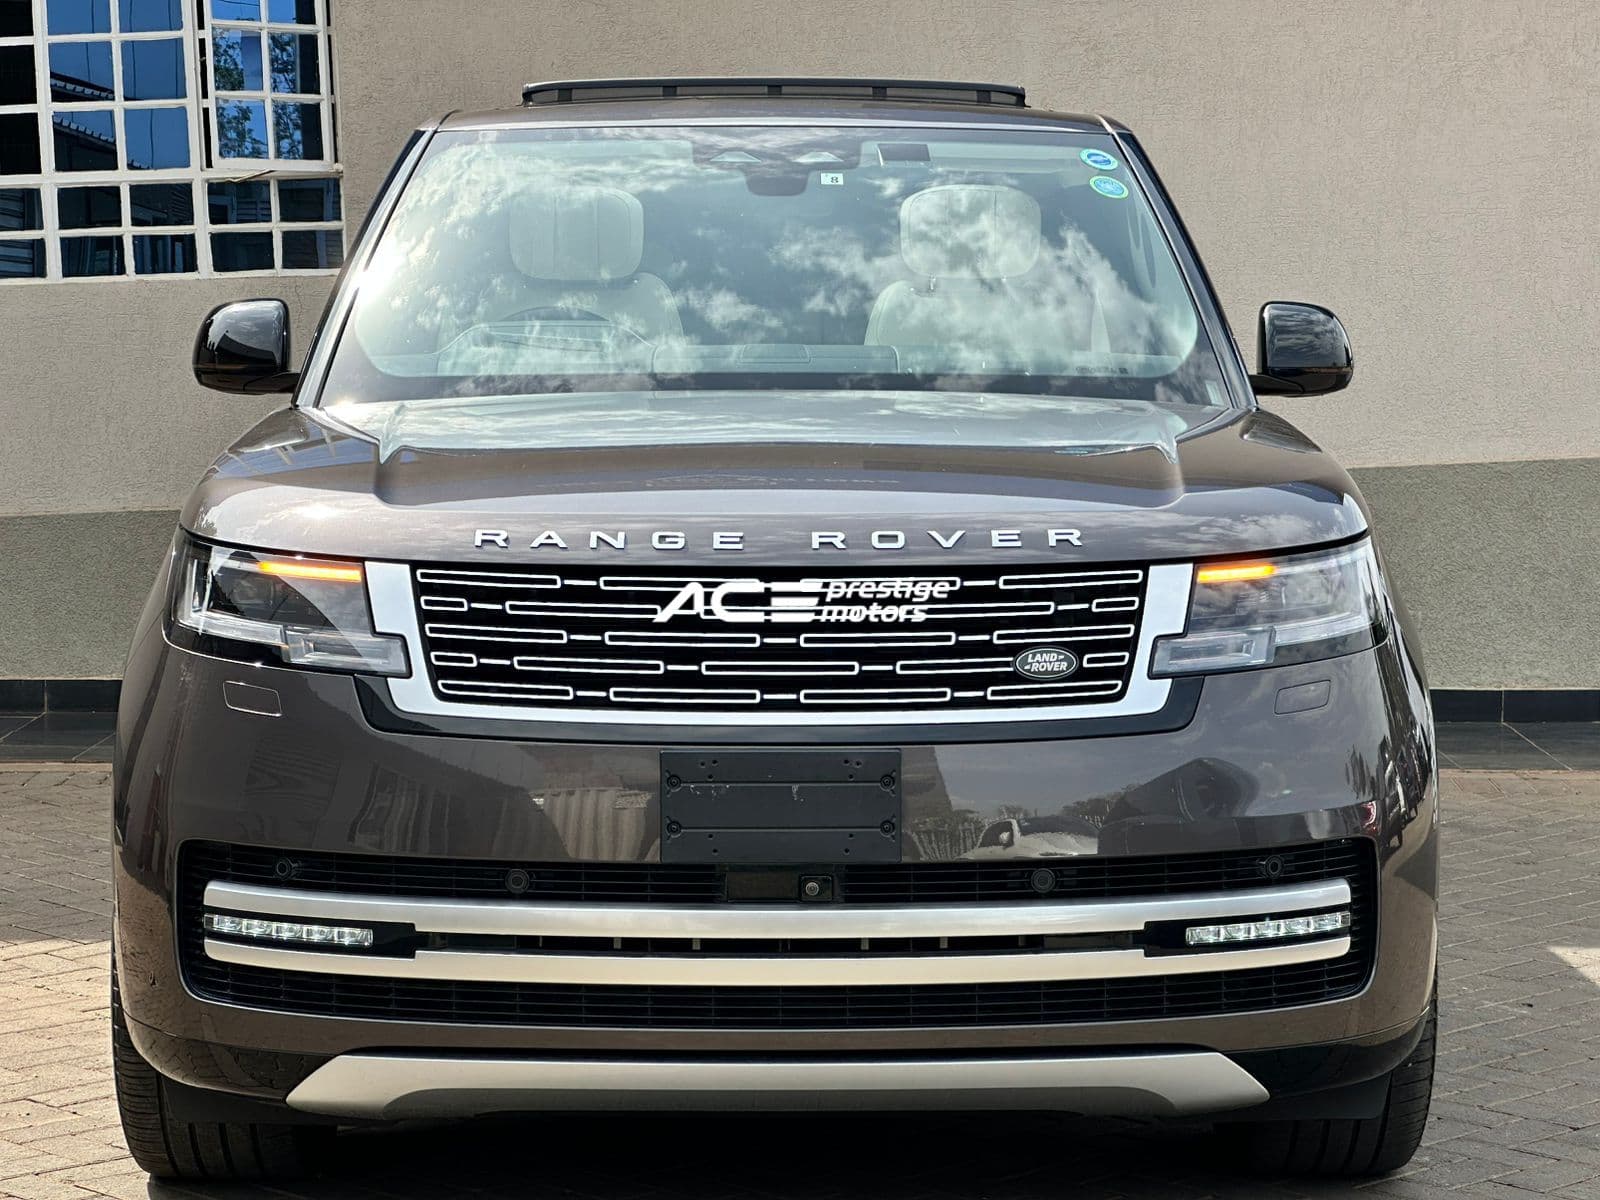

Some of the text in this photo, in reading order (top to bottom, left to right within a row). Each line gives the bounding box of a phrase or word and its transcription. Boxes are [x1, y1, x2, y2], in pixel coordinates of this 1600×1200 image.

[474, 528, 1083, 550] RANGE ROVER
[1027, 653, 1057, 662] LAND
[1030, 661, 1068, 672] ROVER
